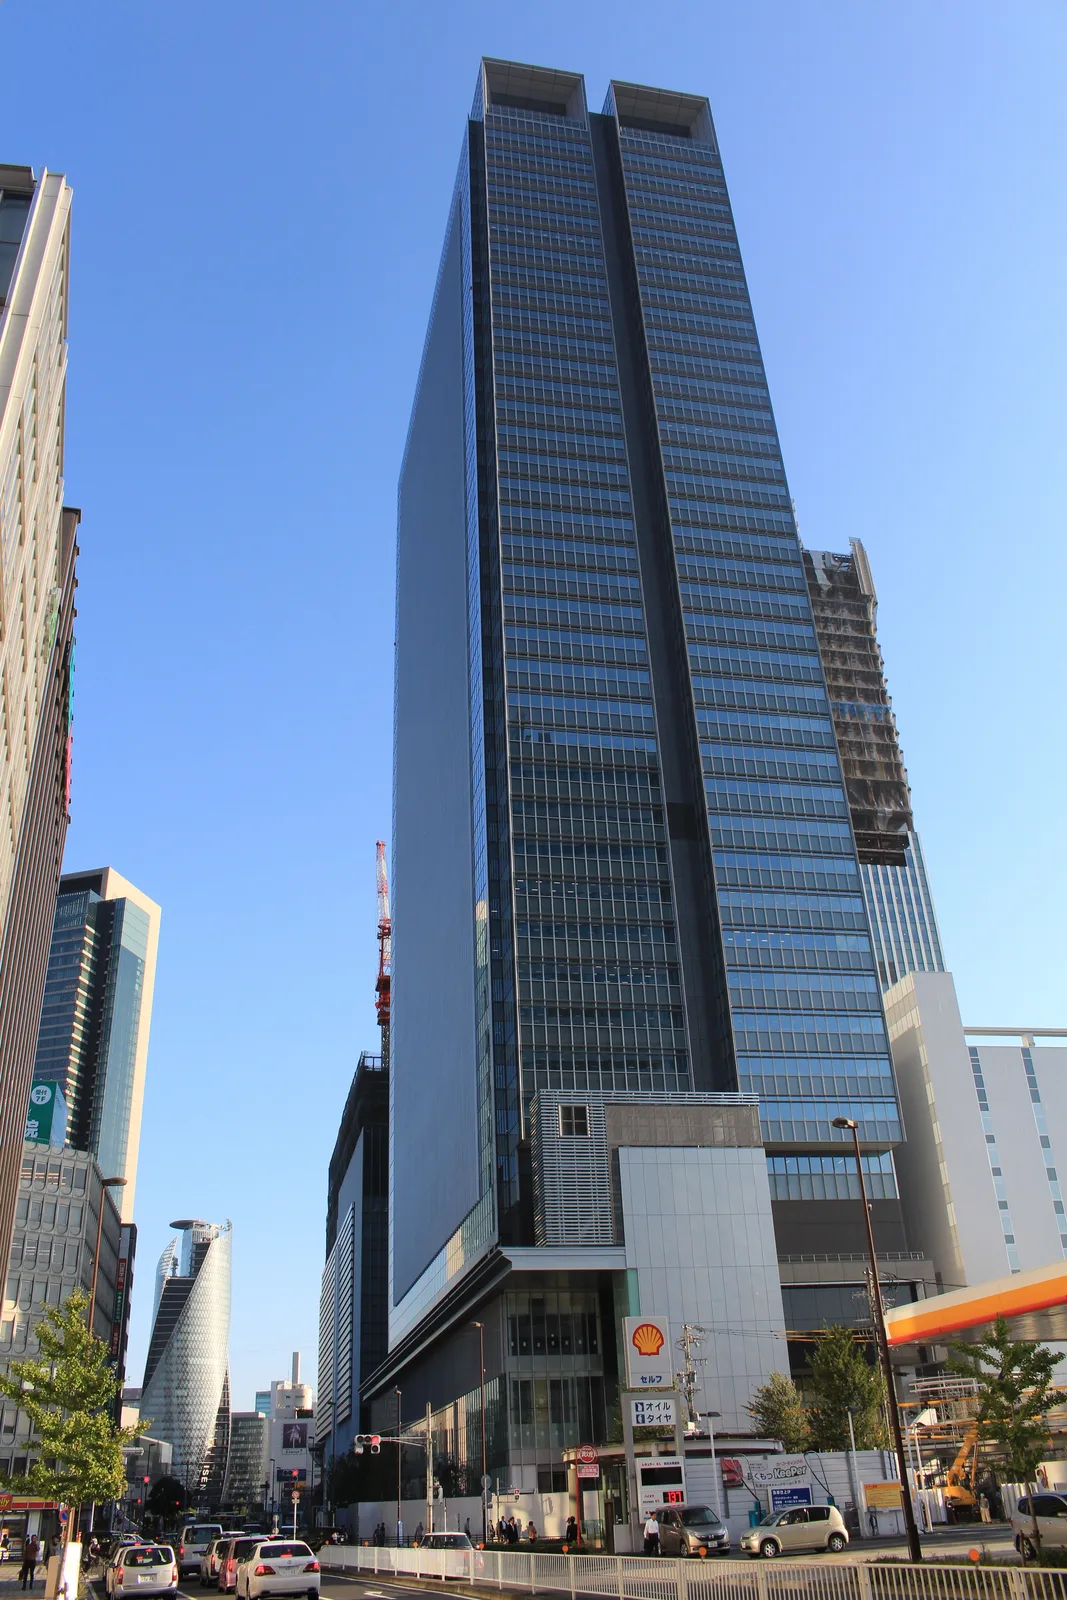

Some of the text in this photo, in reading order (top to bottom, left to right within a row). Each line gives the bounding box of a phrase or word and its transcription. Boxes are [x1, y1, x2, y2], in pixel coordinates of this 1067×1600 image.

[640, 1376, 662, 1384] セルフ
[646, 1402, 670, 1411] オイル
[647, 1414, 672, 1423] タイヤ
[773, 1466, 807, 1480] KeePer
[668, 1492, 682, 1503] 137
